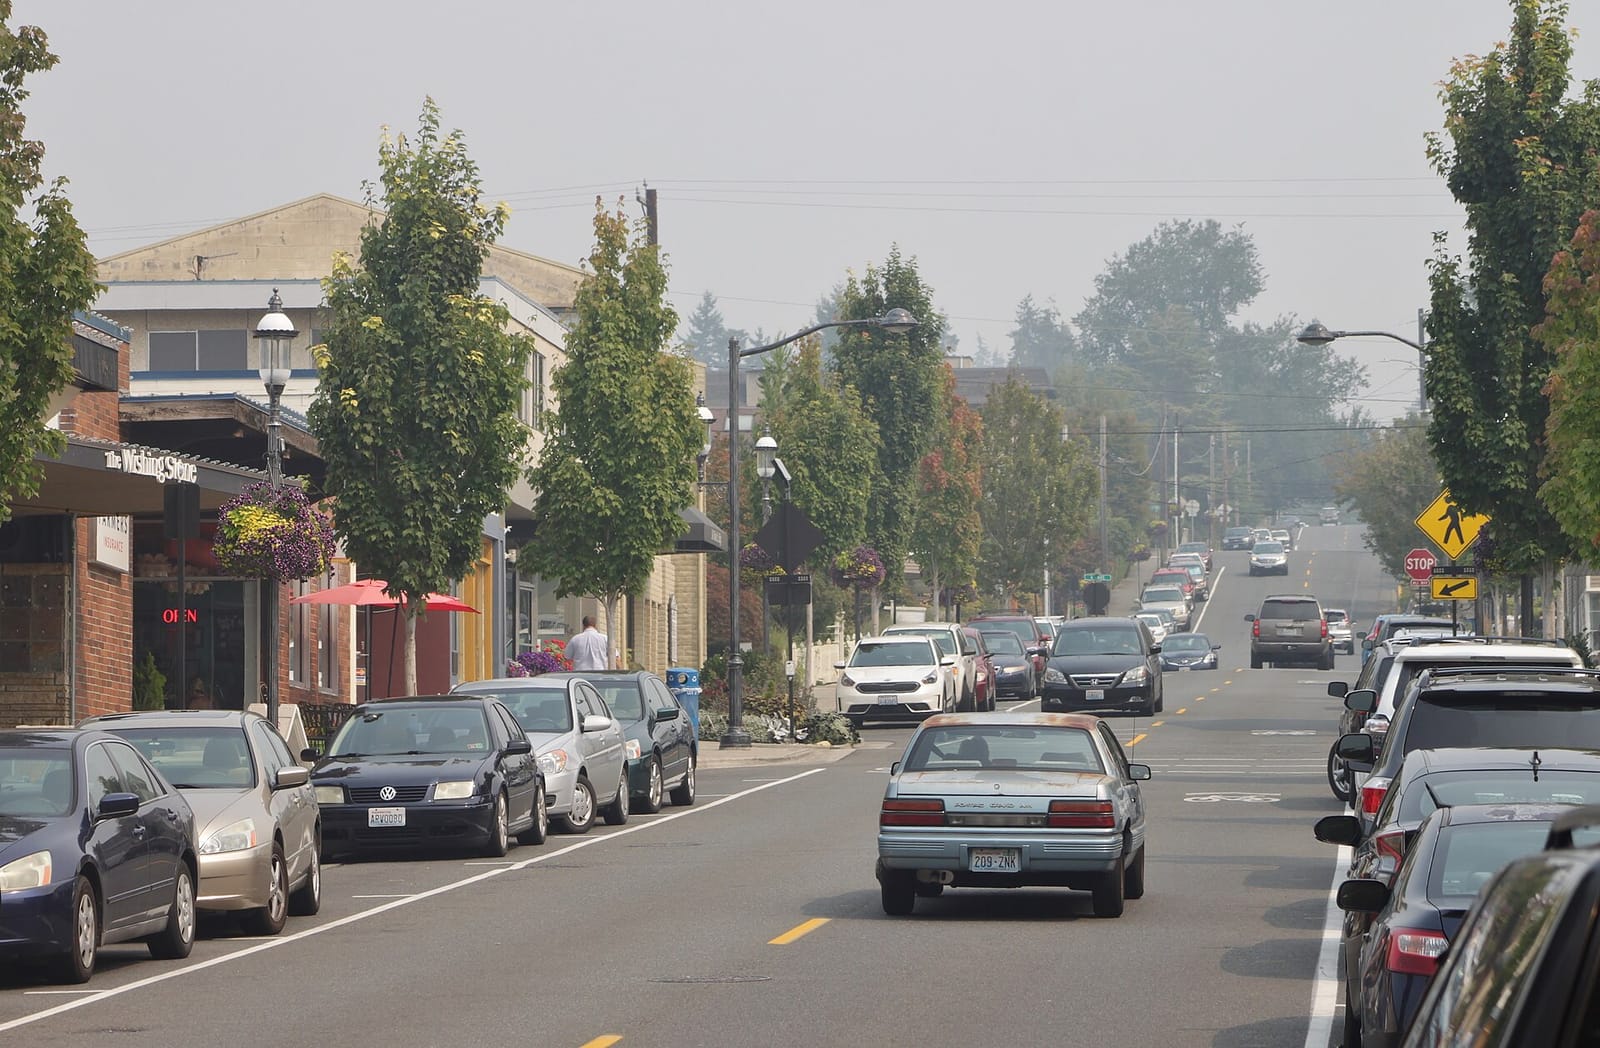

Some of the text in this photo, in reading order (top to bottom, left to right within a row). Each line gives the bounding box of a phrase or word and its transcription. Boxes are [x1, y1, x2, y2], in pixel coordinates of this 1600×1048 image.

[105, 449, 197, 483] The Wishing Stone
[1406, 558, 1434, 570] STOP
[162, 608, 197, 623] ON
